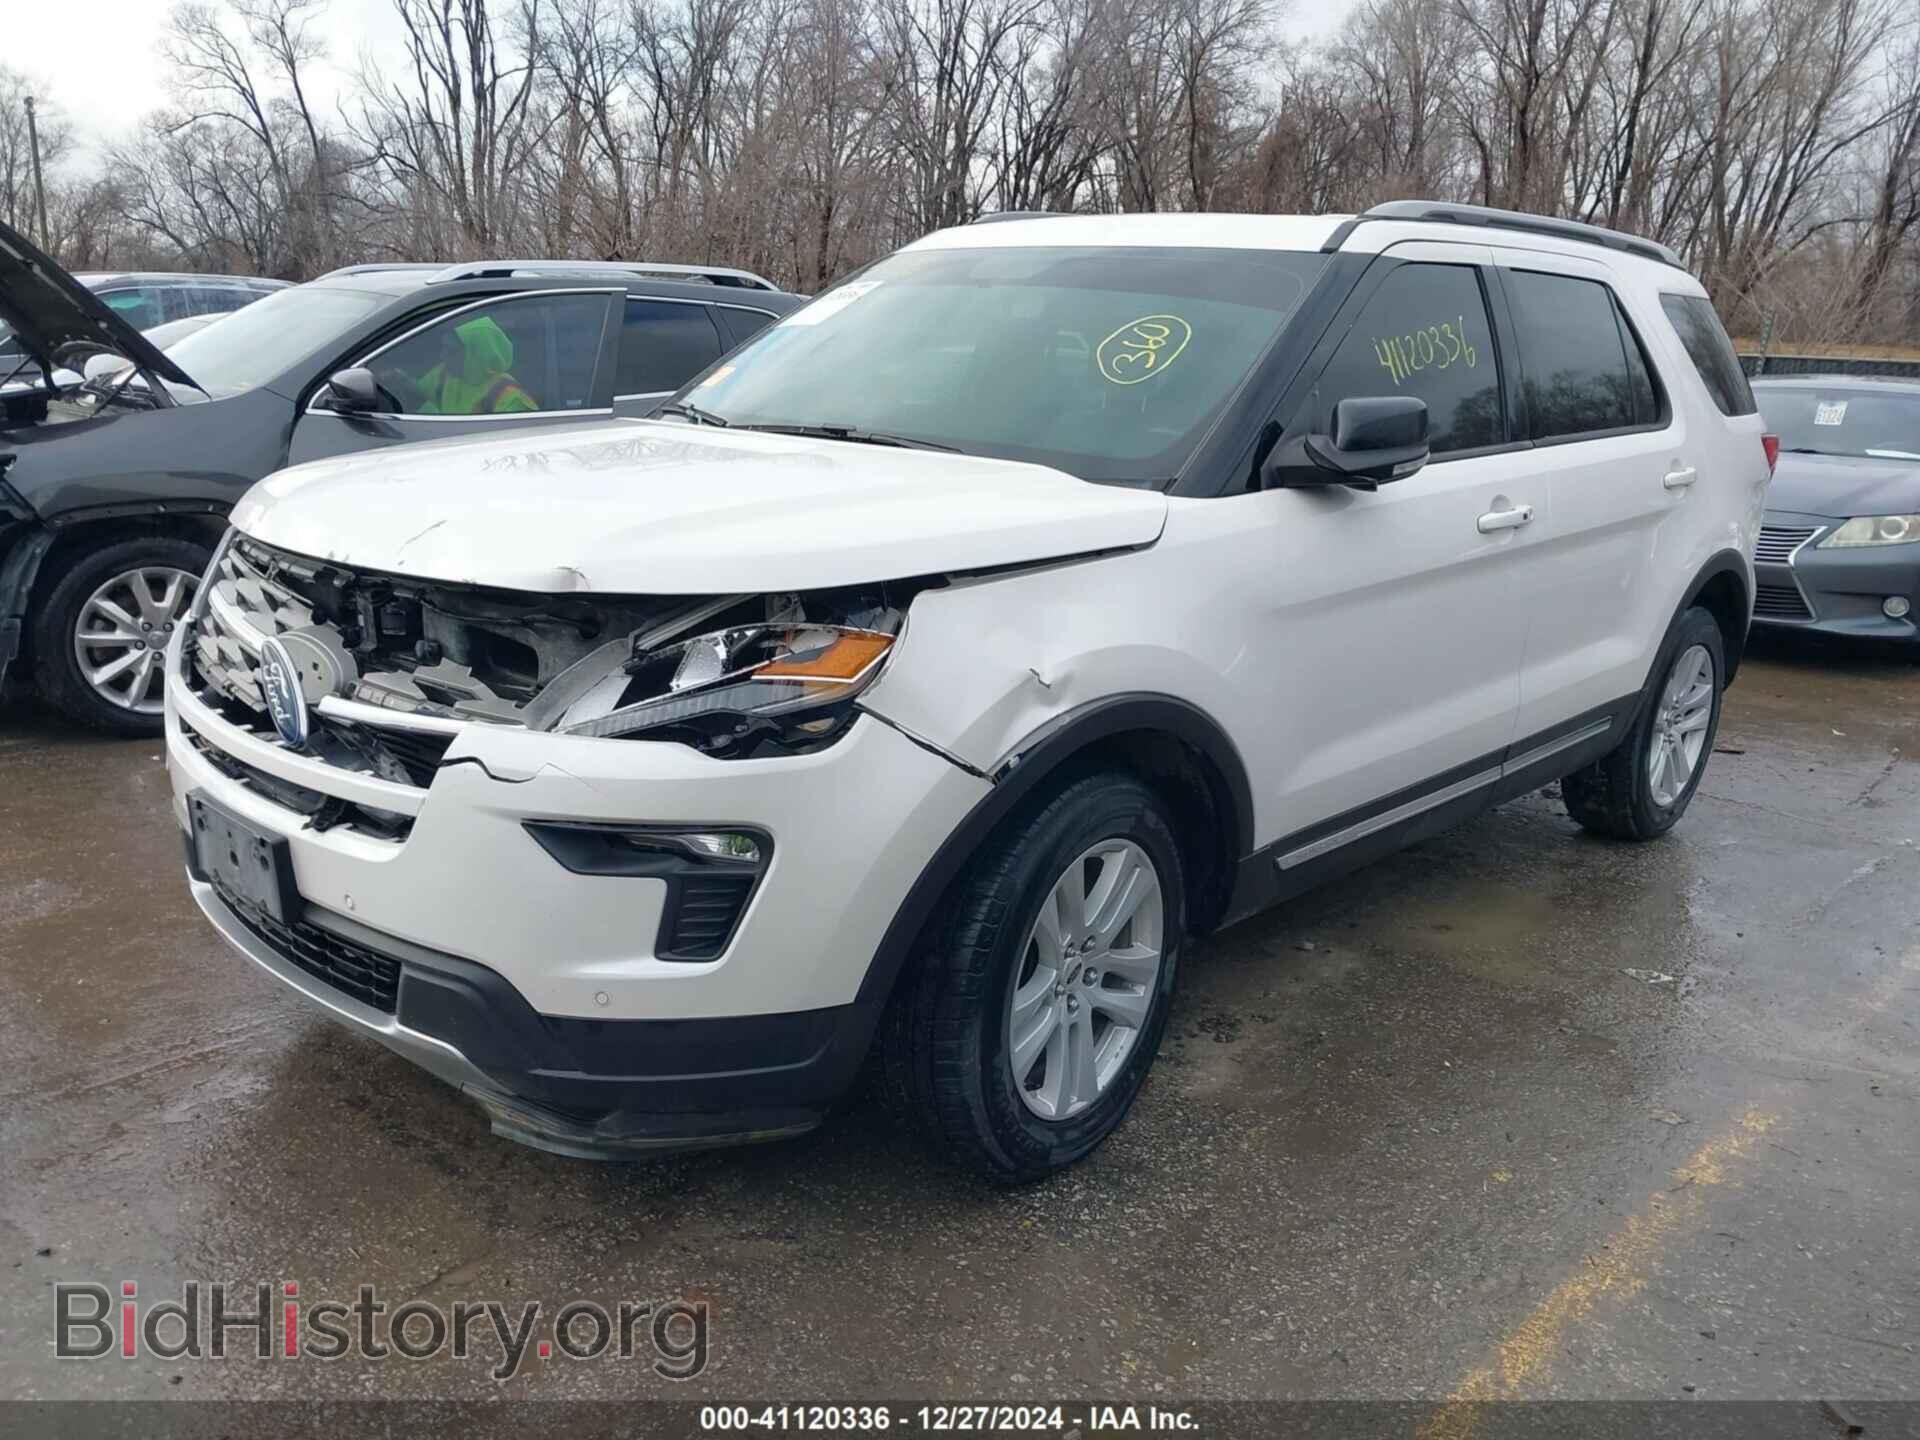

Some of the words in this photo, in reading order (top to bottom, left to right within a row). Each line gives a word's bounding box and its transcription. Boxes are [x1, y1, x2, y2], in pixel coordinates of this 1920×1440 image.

[1111, 322, 1172, 375] 360
[1373, 314, 1477, 387] 41120336
[262, 662, 292, 724] Ford
